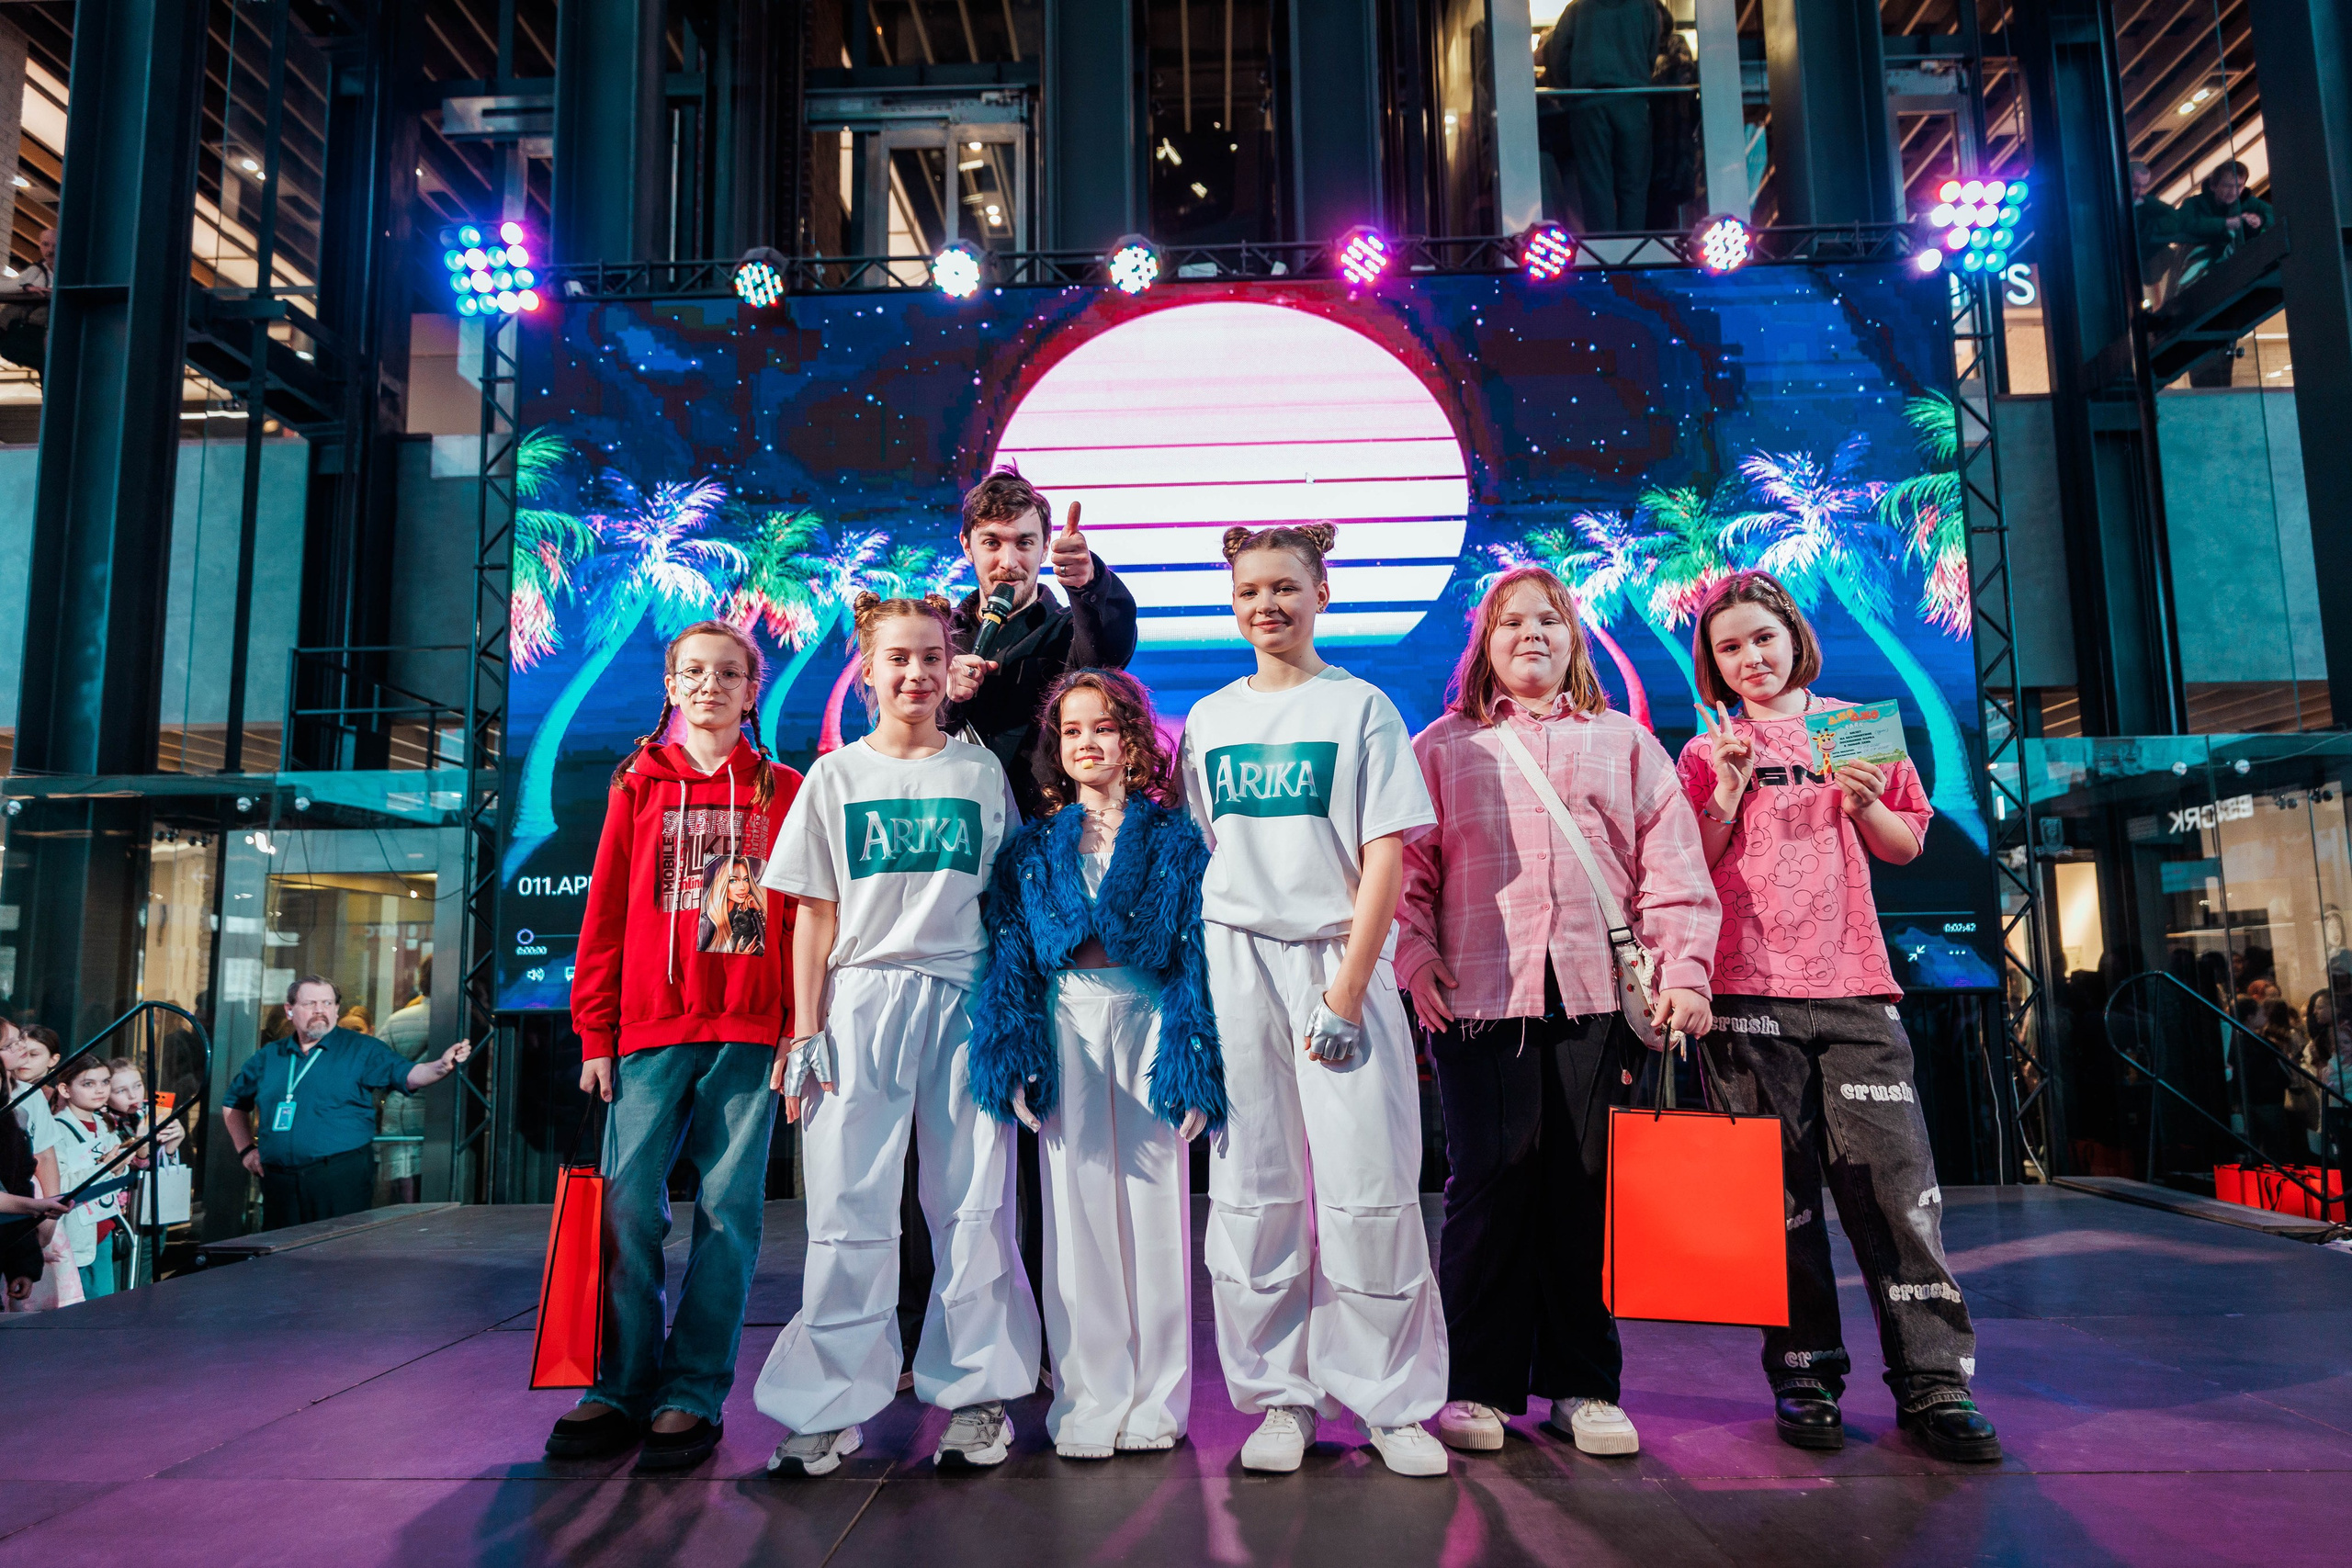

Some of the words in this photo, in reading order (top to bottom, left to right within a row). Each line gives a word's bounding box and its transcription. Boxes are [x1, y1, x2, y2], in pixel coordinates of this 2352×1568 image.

[1215, 755, 1318, 805] ARIKA
[662, 809, 743, 837] SHARE
[741, 813, 753, 856] ROUPS
[761, 815, 770, 861] RIENDS
[859, 810, 972, 862] ARIKA
[662, 836, 674, 893] MOBILE
[1711, 1015, 1781, 1036] crush
[1840, 1081, 1914, 1103] crush
[1889, 1282, 1962, 1303] crush
